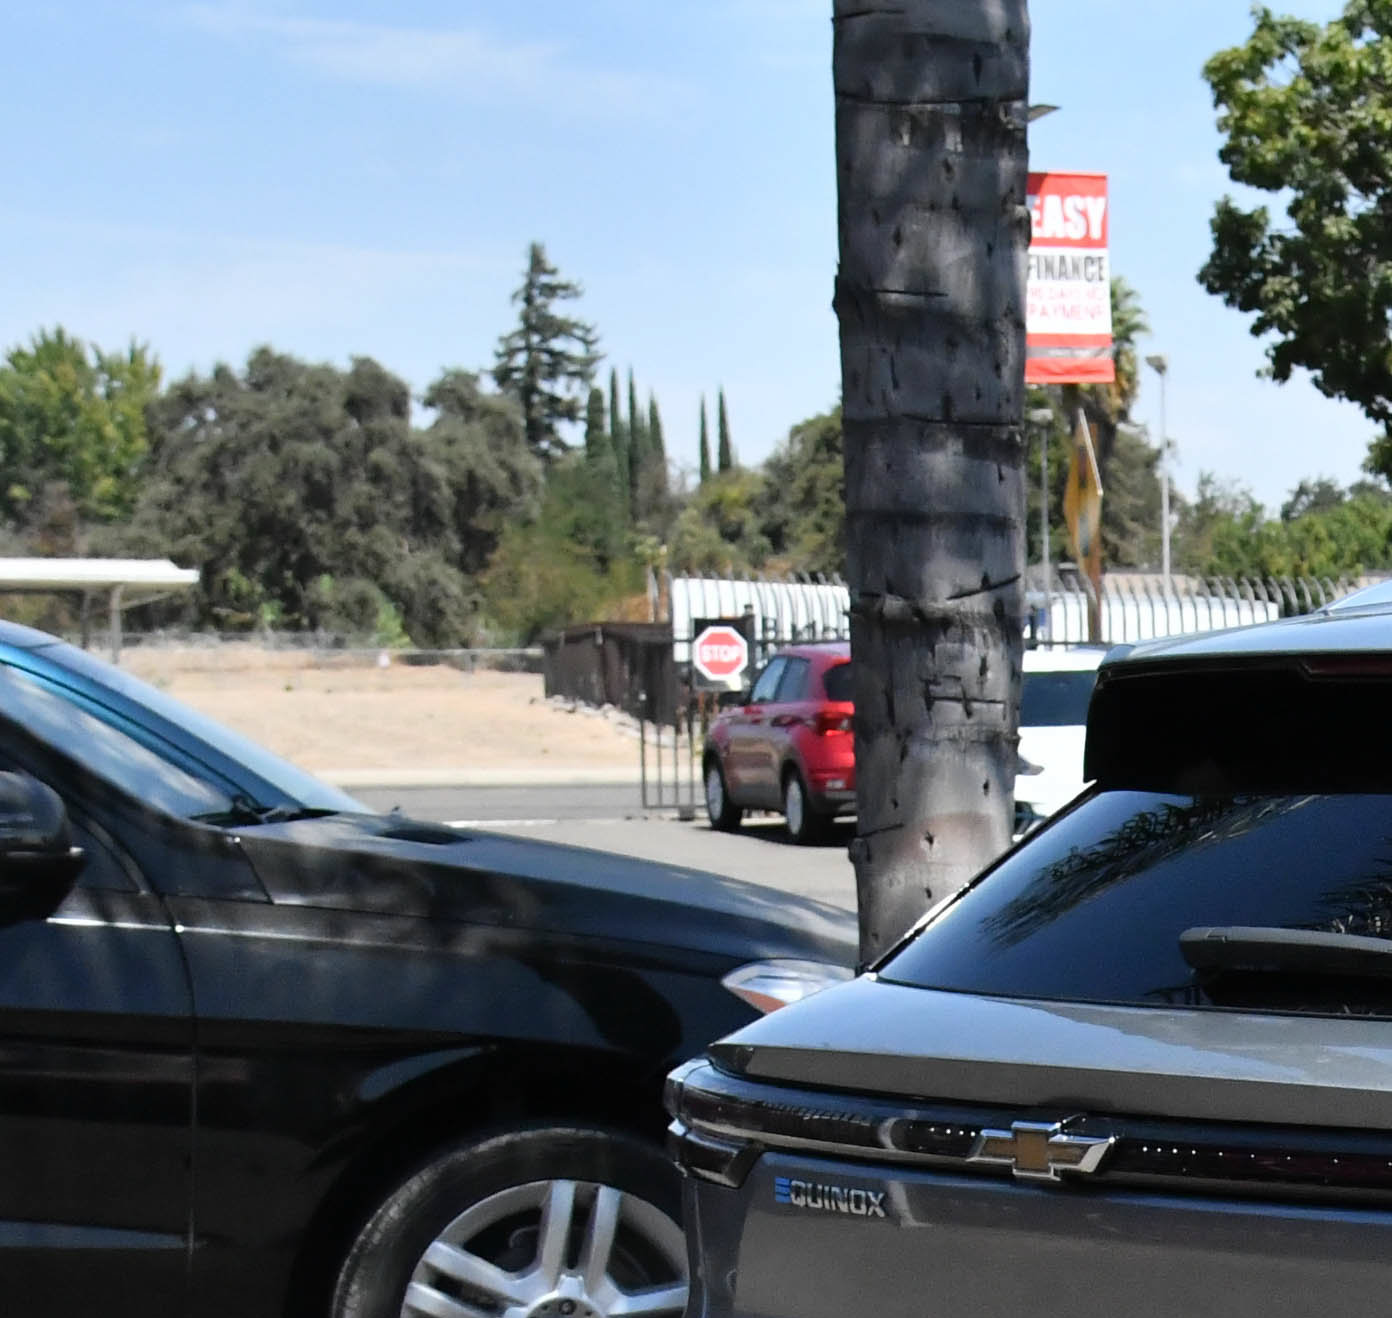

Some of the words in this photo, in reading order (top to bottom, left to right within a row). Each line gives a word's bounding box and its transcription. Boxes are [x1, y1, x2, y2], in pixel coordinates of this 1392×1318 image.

[1026, 193, 1106, 240] EASY
[1027, 254, 1105, 282] FINANCE
[700, 644, 741, 662] STOP
[775, 1178, 885, 1218] EQUINOX
